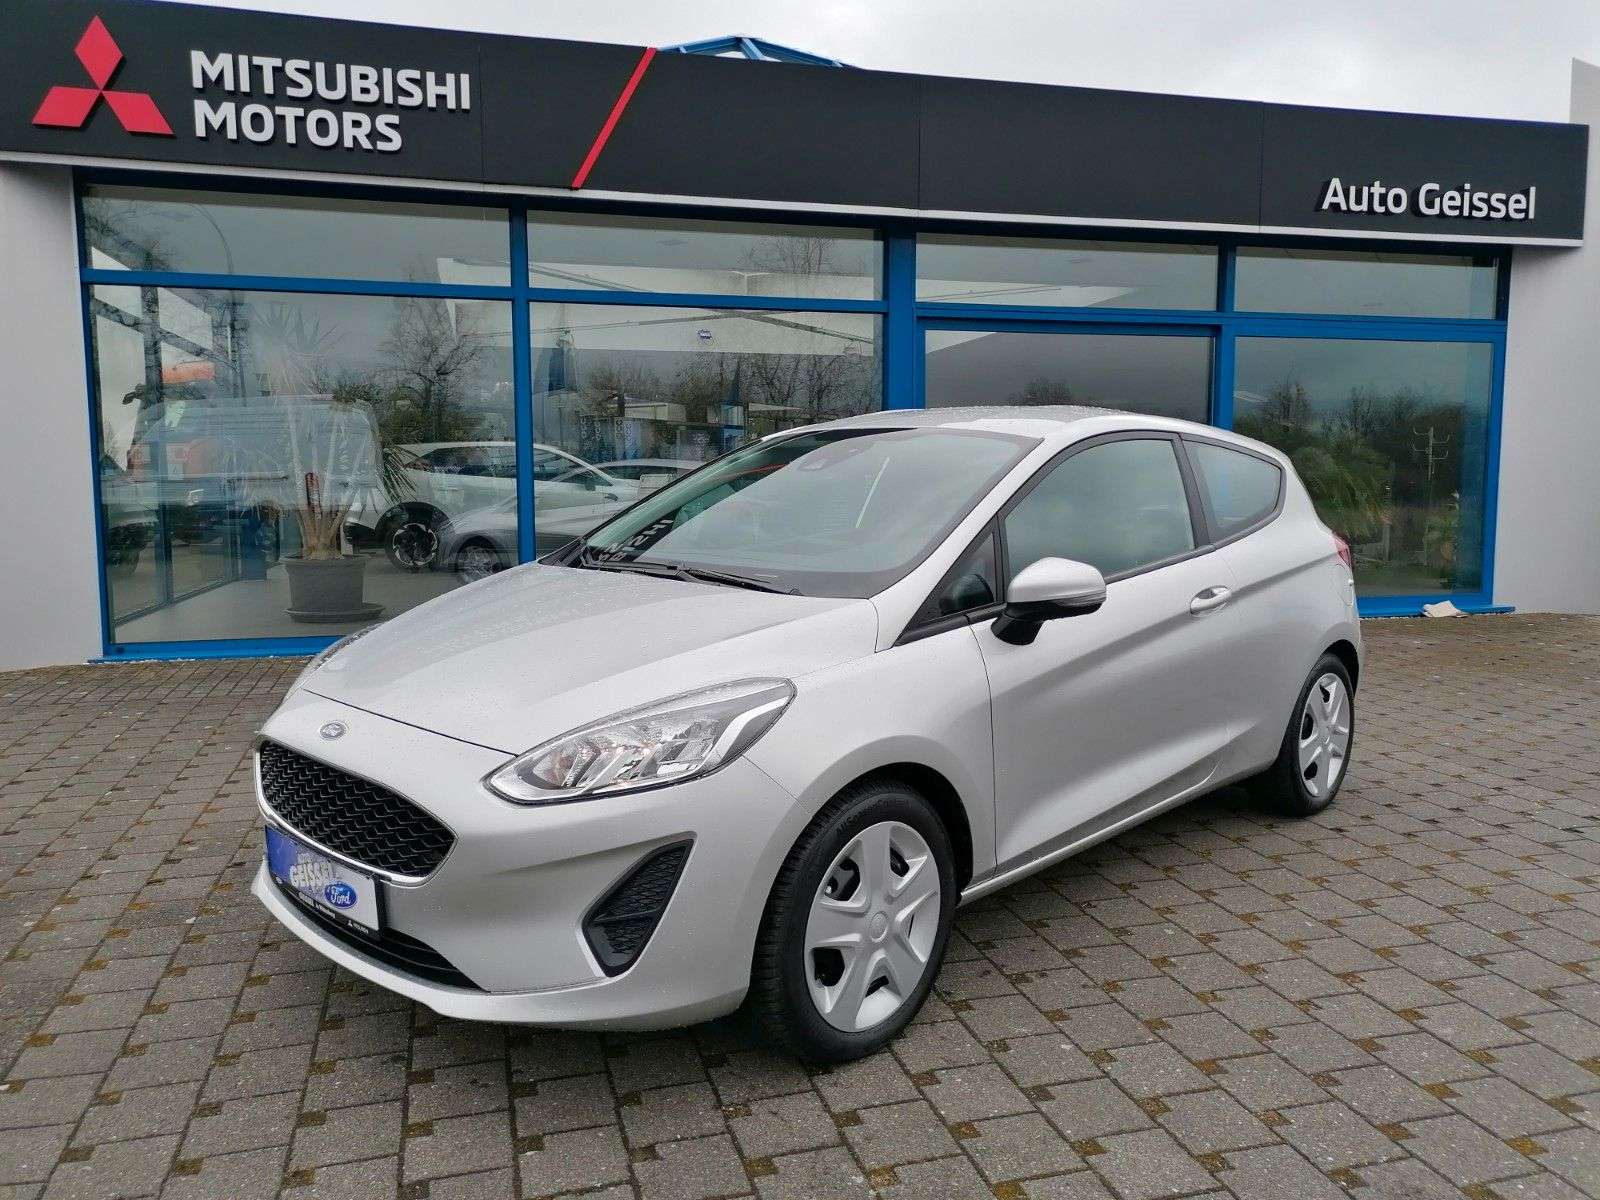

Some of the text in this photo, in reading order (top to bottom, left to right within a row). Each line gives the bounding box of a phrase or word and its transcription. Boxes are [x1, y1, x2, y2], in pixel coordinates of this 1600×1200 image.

[190, 49, 471, 111] MITSUBISHI
[193, 99, 403, 153] MOTORS
[1321, 177, 1537, 220] Auto Geissel
